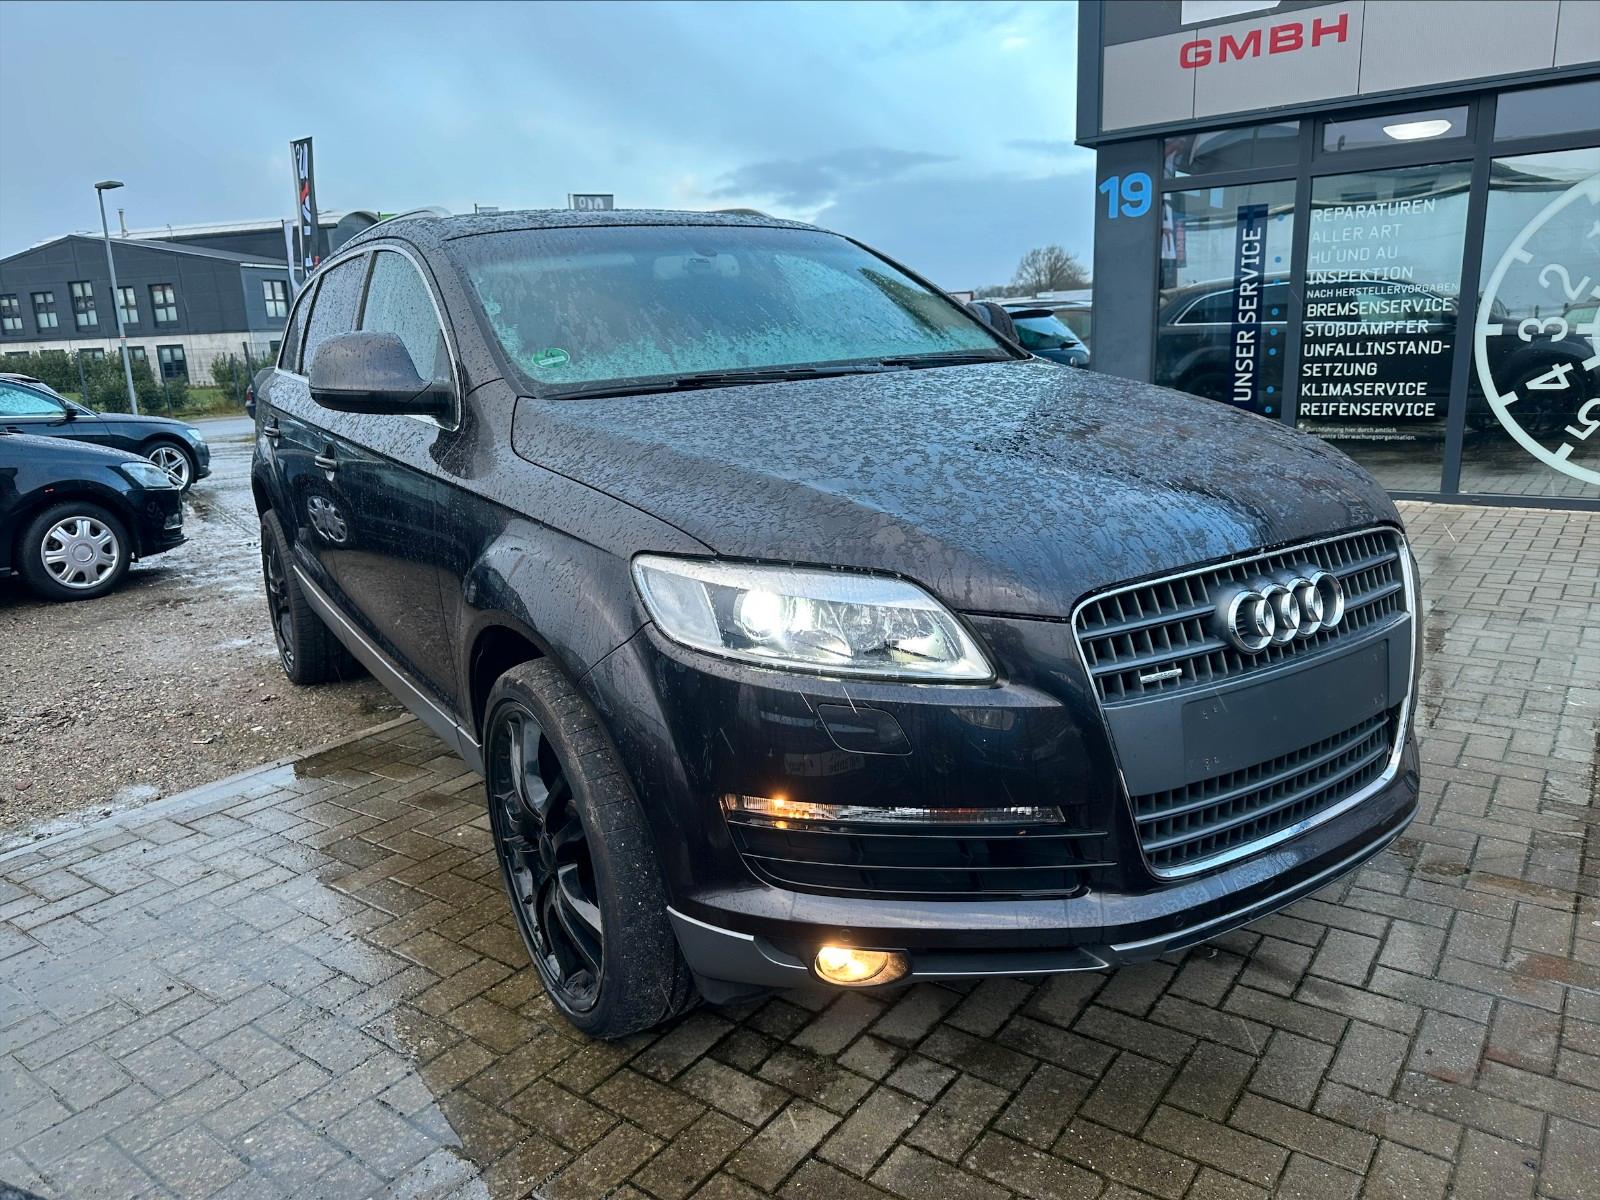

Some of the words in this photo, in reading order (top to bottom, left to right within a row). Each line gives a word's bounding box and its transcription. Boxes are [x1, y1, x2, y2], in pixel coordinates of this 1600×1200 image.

[1179, 13, 1349, 70] GMBH
[1098, 172, 1153, 219] 19
[1311, 198, 1437, 223] REPARATUREN
[1311, 227, 1364, 243] ALLER
[1368, 224, 1403, 240] ART
[1336, 247, 1370, 263] UND
[1375, 246, 1399, 260] AU
[1237, 226, 1262, 324] SERVICE
[1307, 266, 1415, 285] INSPEKTION
[1538, 263, 1592, 301] 2
[1306, 289, 1334, 299] NACH
[1335, 282, 1460, 298] HERSTELLERVORGABEN
[1306, 297, 1454, 318] BREMSENSERVICE
[1304, 318, 1430, 338] STOßDÄMPFER
[1517, 316, 1569, 343] 3
[1303, 340, 1452, 358] UNFALLINSTAND-
[1233, 330, 1256, 401] UNSER
[1302, 362, 1379, 377] SETZUNG
[1525, 362, 1574, 390] 4
[1301, 382, 1428, 397] KLIMASERVICE
[1299, 402, 1437, 417] REIFENSERVICE
